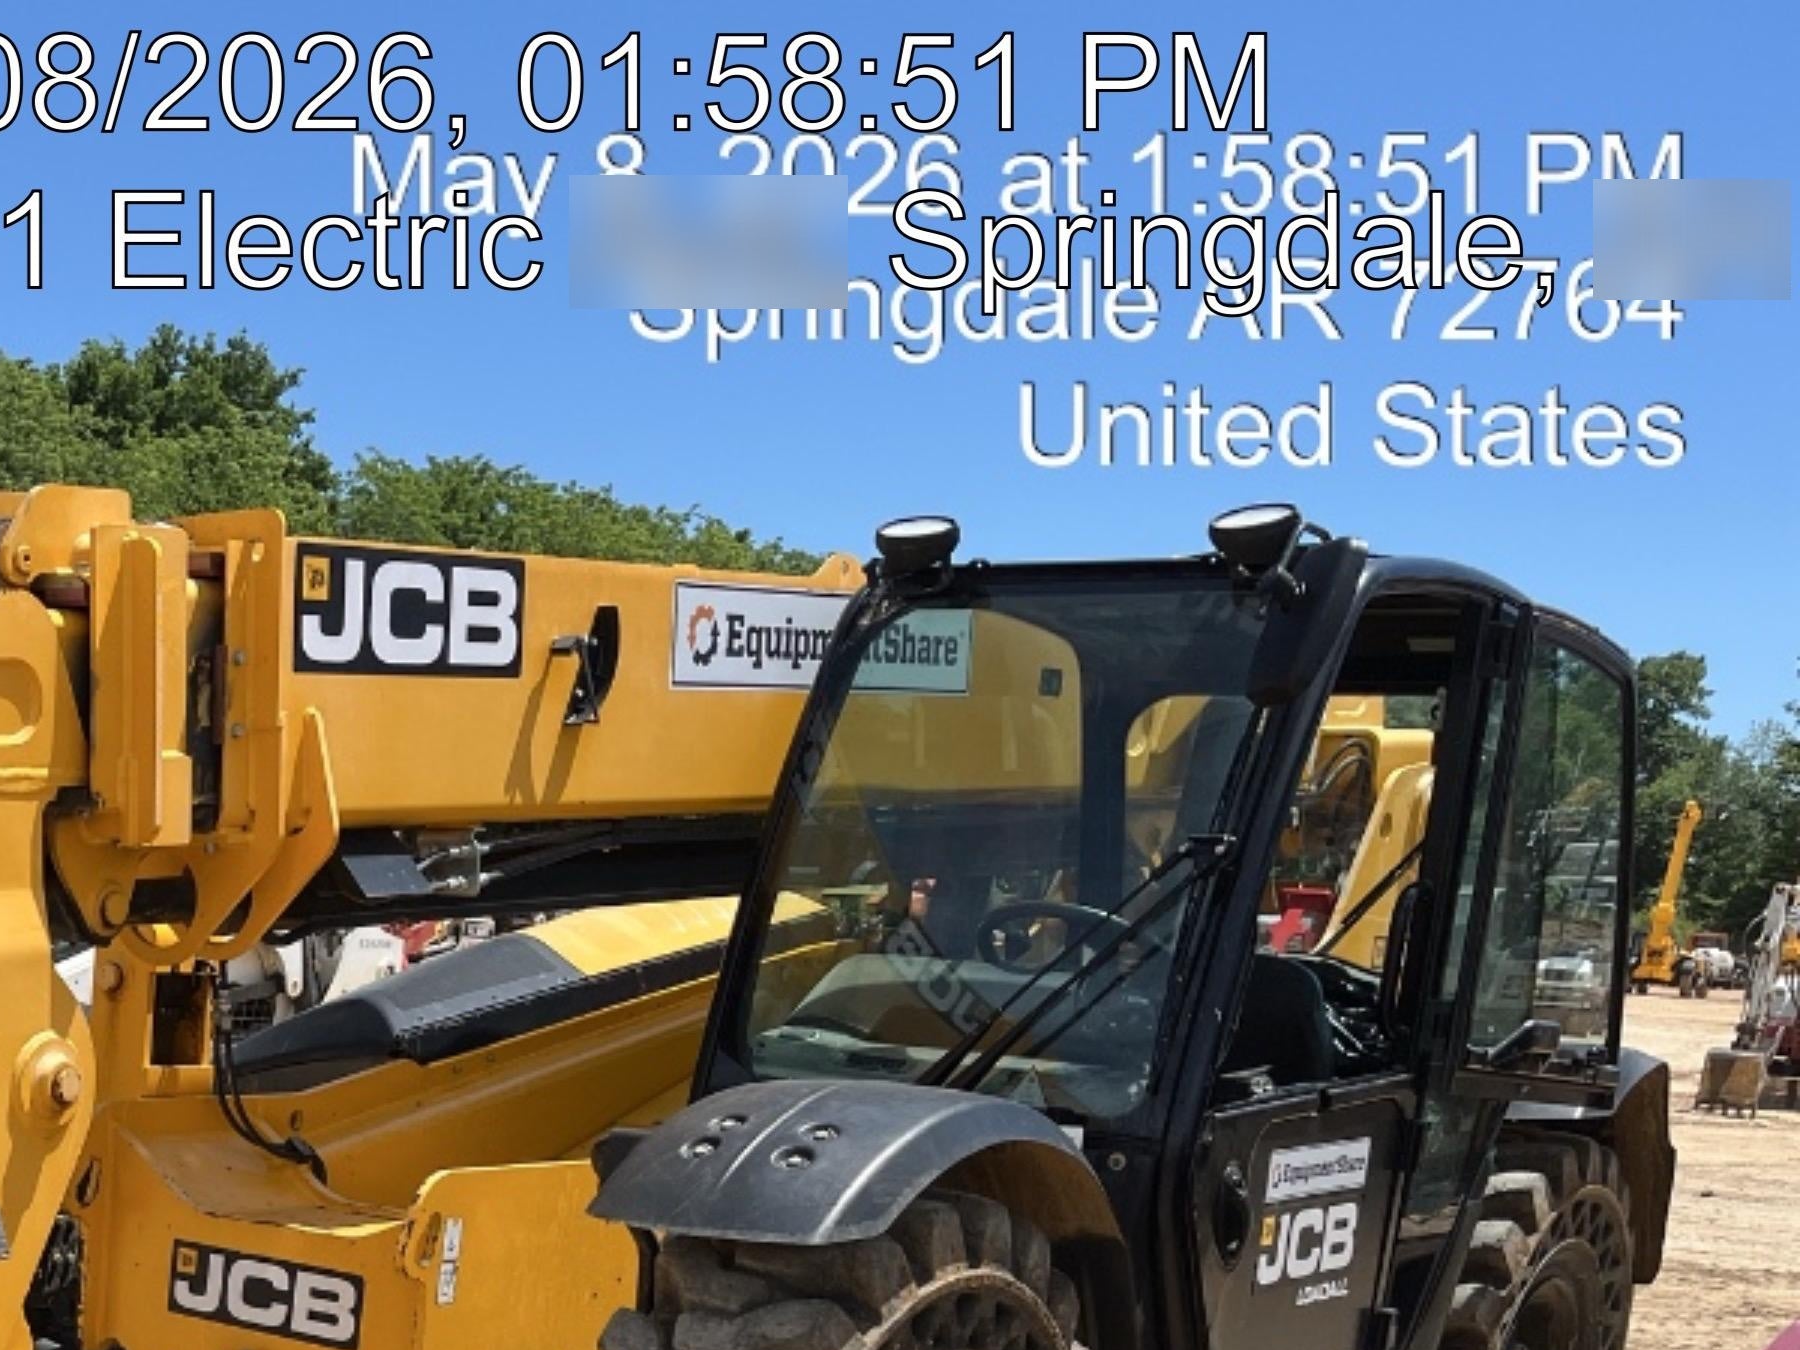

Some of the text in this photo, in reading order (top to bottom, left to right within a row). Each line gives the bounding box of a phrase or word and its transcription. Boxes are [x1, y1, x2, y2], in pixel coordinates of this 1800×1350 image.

[301, 556, 518, 667] JCB
[725, 614, 959, 669] EquipmtShare
[1256, 1202, 1357, 1285] JCB
[173, 1252, 357, 1342] JCB
